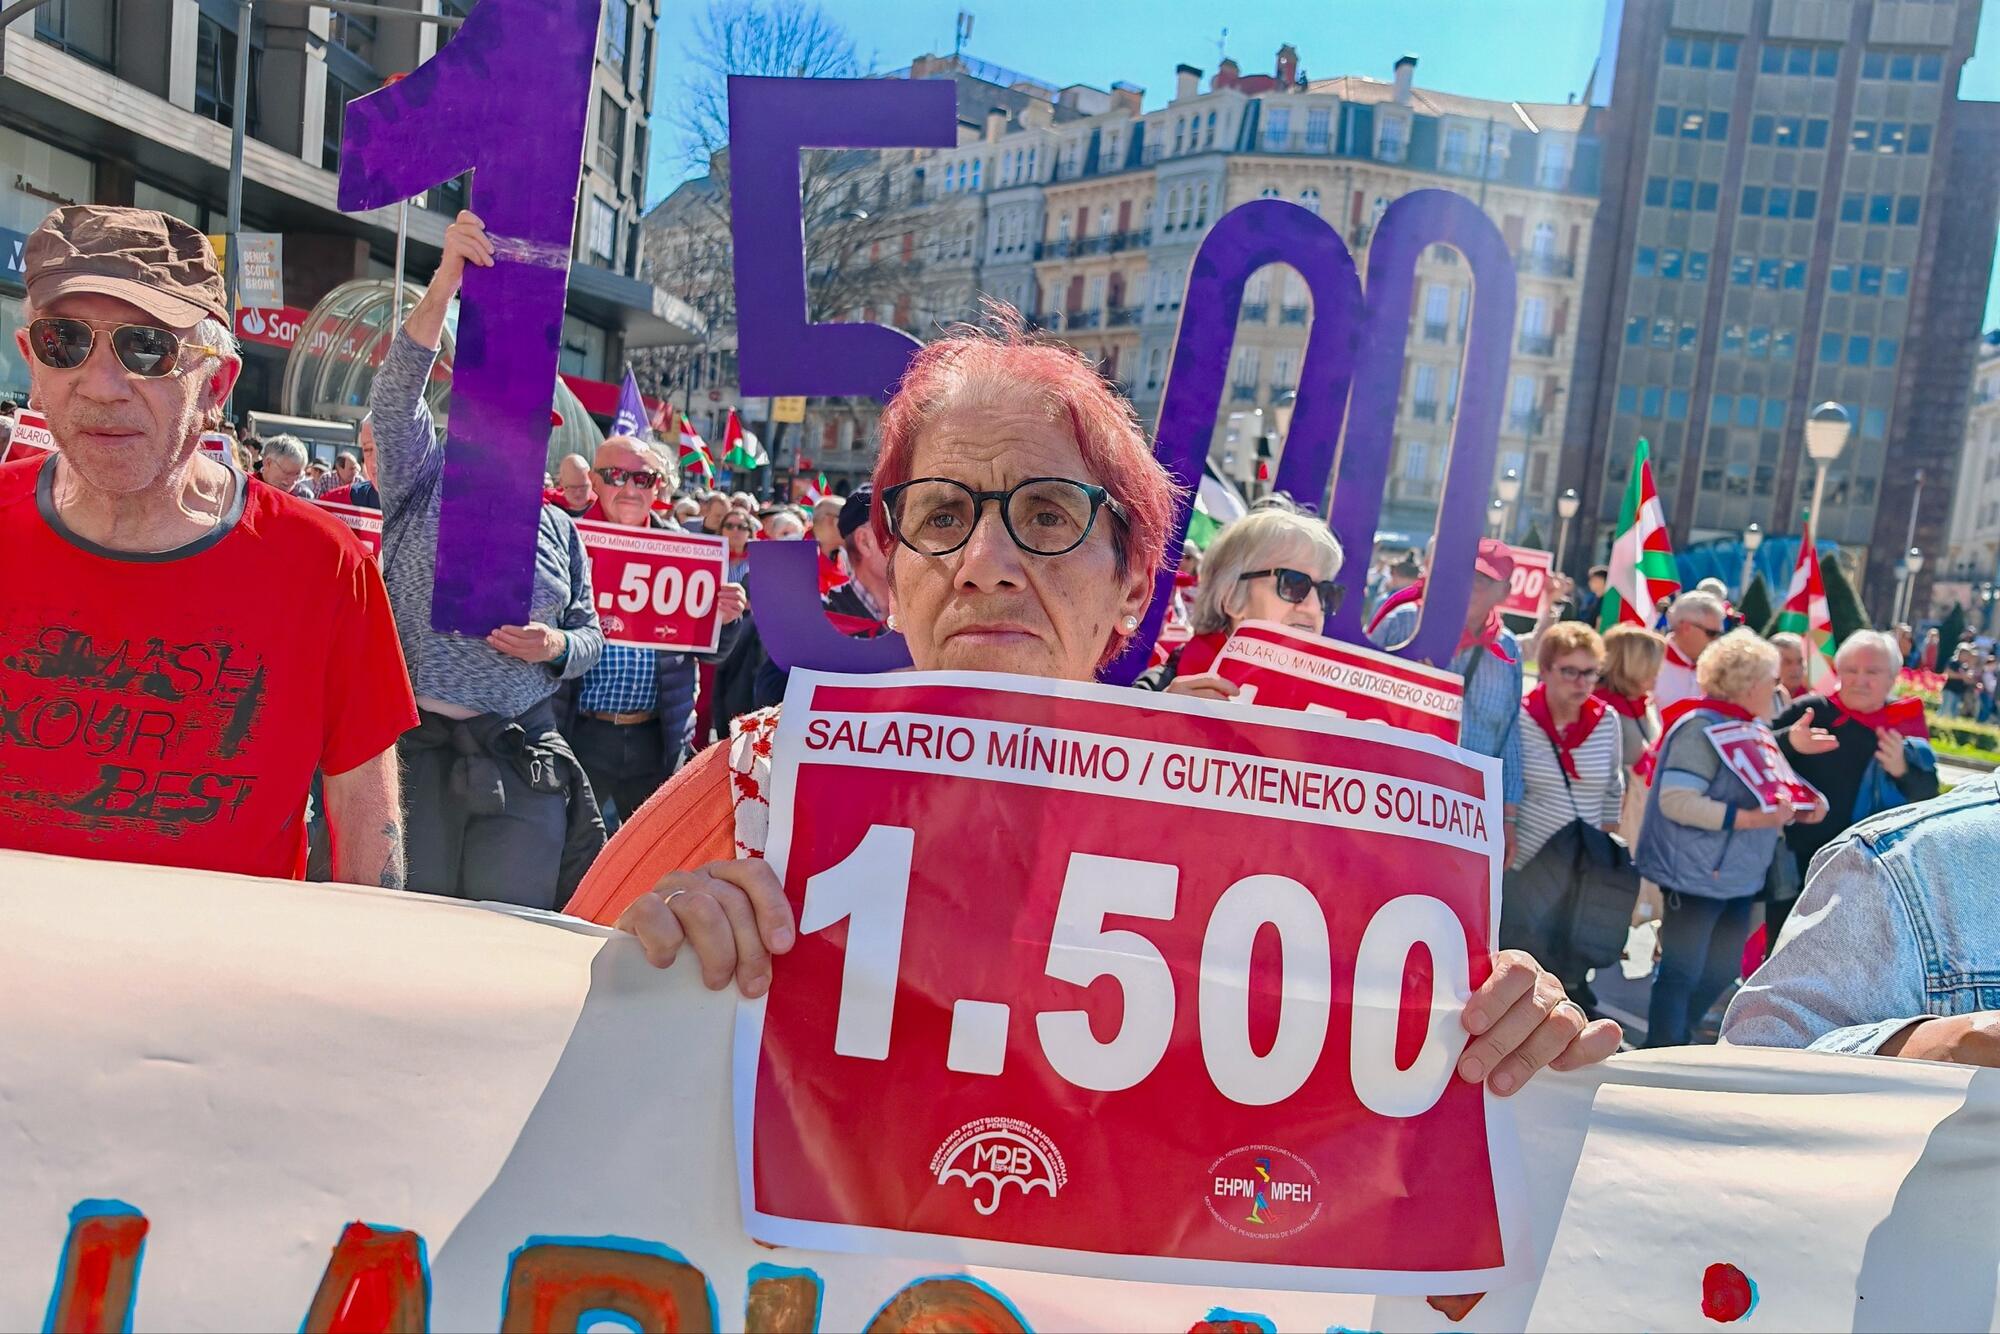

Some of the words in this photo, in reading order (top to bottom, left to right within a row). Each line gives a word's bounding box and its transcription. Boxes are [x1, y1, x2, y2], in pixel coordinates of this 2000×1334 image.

[243, 251, 271, 263] DENISE
[244, 265, 269, 277] SCOTT
[245, 277, 275, 289] BROWN
[14, 427, 50, 444] SALARIO
[693, 548, 723, 558] SOLDATA
[589, 558, 716, 619] .500
[1226, 640, 1289, 666] SALARIO
[1350, 671, 1423, 704] GUTXIENEKO
[98, 765, 258, 824] BEST
[805, 719, 975, 763] SALARIO
[987, 727, 1130, 783] MÍNIMO
[1138, 752, 1154, 786] /
[1162, 753, 1366, 815] GUTXIENEKO
[1374, 783, 1488, 842] SOLDATA
[800, 824, 1471, 1118] 1.500
[930, 1129, 961, 1170] BIZKAIKO
[961, 1116, 1032, 1132] PENTSIODUNEN
[1032, 1127, 1069, 1185] MUGIMENDUA
[933, 1130, 973, 1176] MOVIMIENTO
[974, 1124, 986, 1133] DE
[986, 1122, 1040, 1143] PENSIONISTAS
[1214, 1177, 1255, 1198] EHPM
[1271, 1181, 1311, 1202] MPEH
